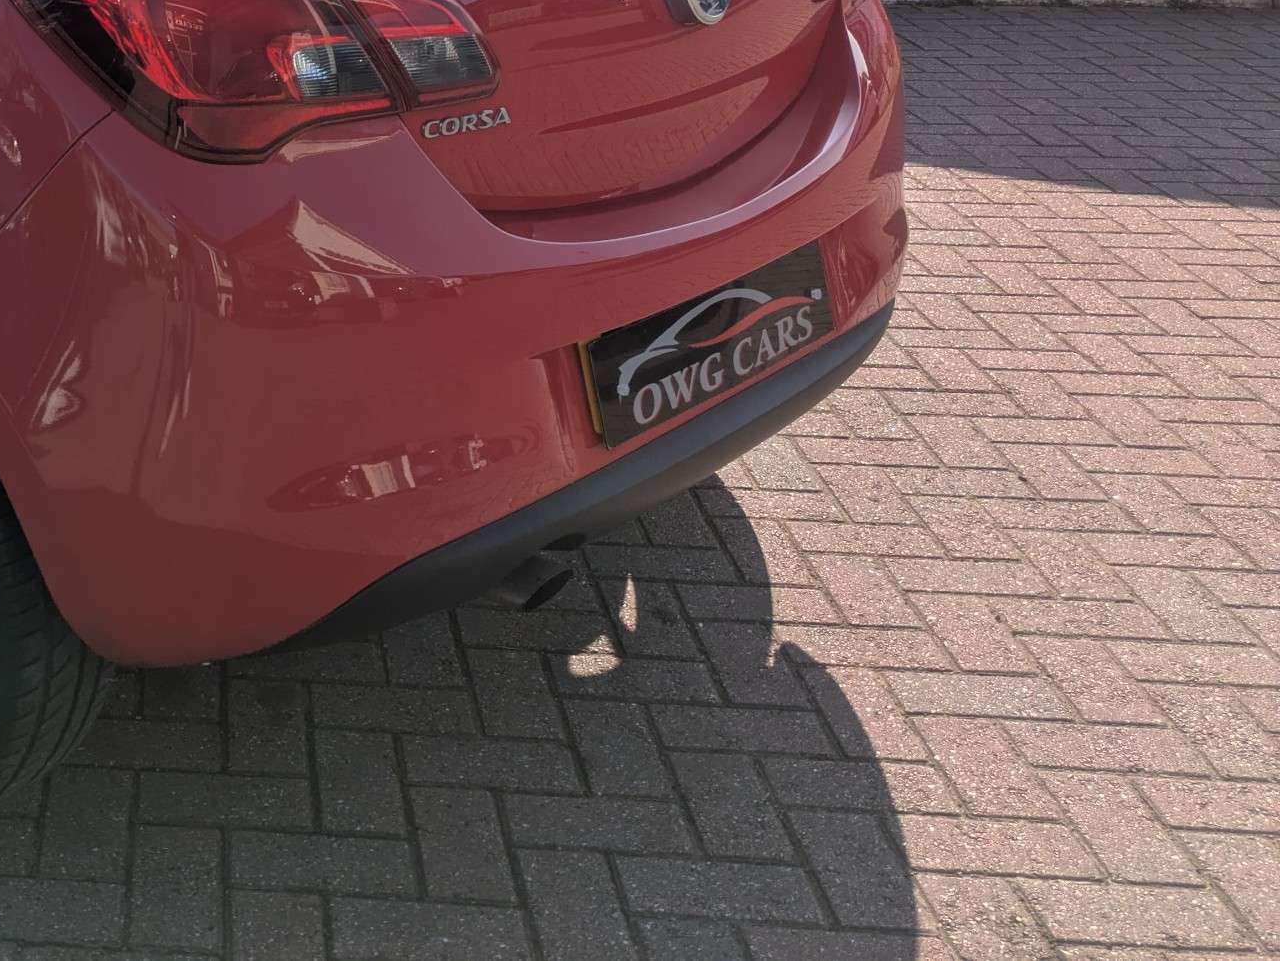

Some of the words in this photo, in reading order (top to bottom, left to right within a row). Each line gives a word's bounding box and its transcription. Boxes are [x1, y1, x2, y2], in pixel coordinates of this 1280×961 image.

[422, 106, 512, 139] CORSA
[632, 352, 725, 425] OWG
[732, 305, 814, 377] CARS
